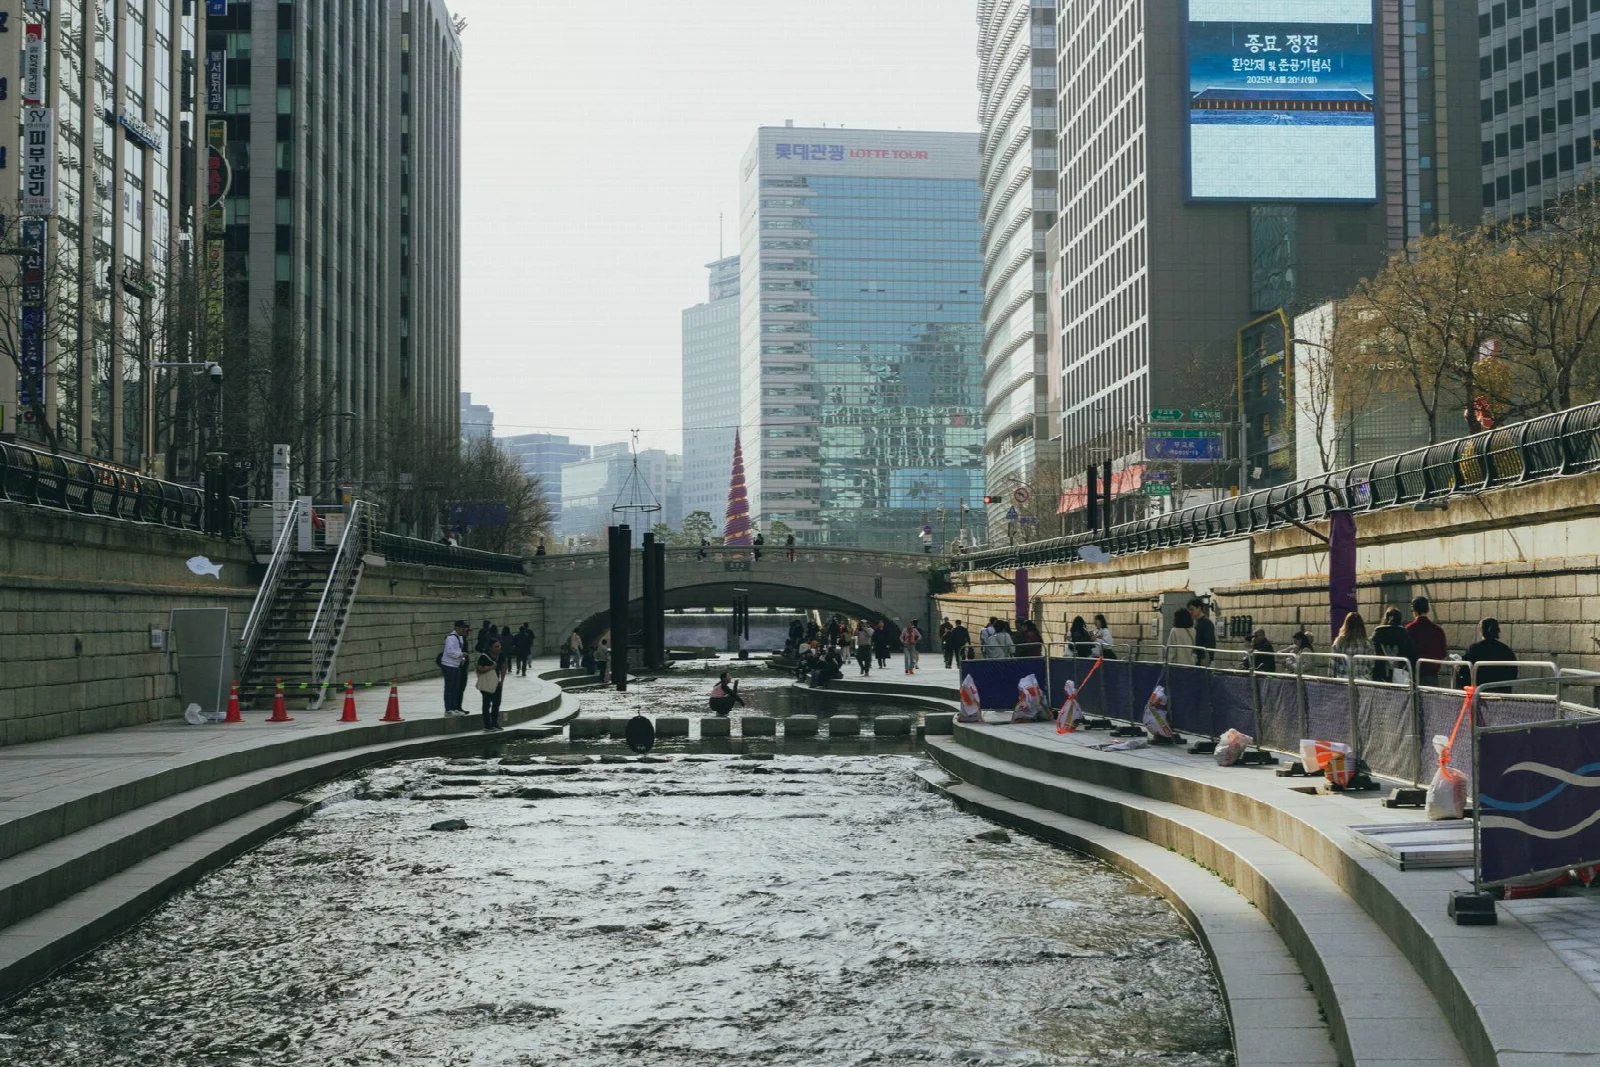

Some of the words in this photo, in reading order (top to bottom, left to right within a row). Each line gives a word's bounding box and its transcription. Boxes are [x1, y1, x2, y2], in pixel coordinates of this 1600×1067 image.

[1244, 34, 1281, 53] 종묘
[1286, 34, 1319, 53] 정전
[1231, 58, 1265, 72] 환안제
[1268, 61, 1276, 71] 및
[1278, 58, 1331, 72] 준공기념식
[211, 62, 222, 104] 서린치과
[1246, 76, 1272, 84] 2025년
[1274, 76, 1286, 84] 4월
[776, 143, 845, 161] 롯데관광
[850, 149, 890, 159] LOTTE
[893, 150, 929, 160] TOUR
[28, 130, 45, 197] 피부관리
[277, 447, 283, 456] 4
[1173, 441, 1195, 449] 무교로
